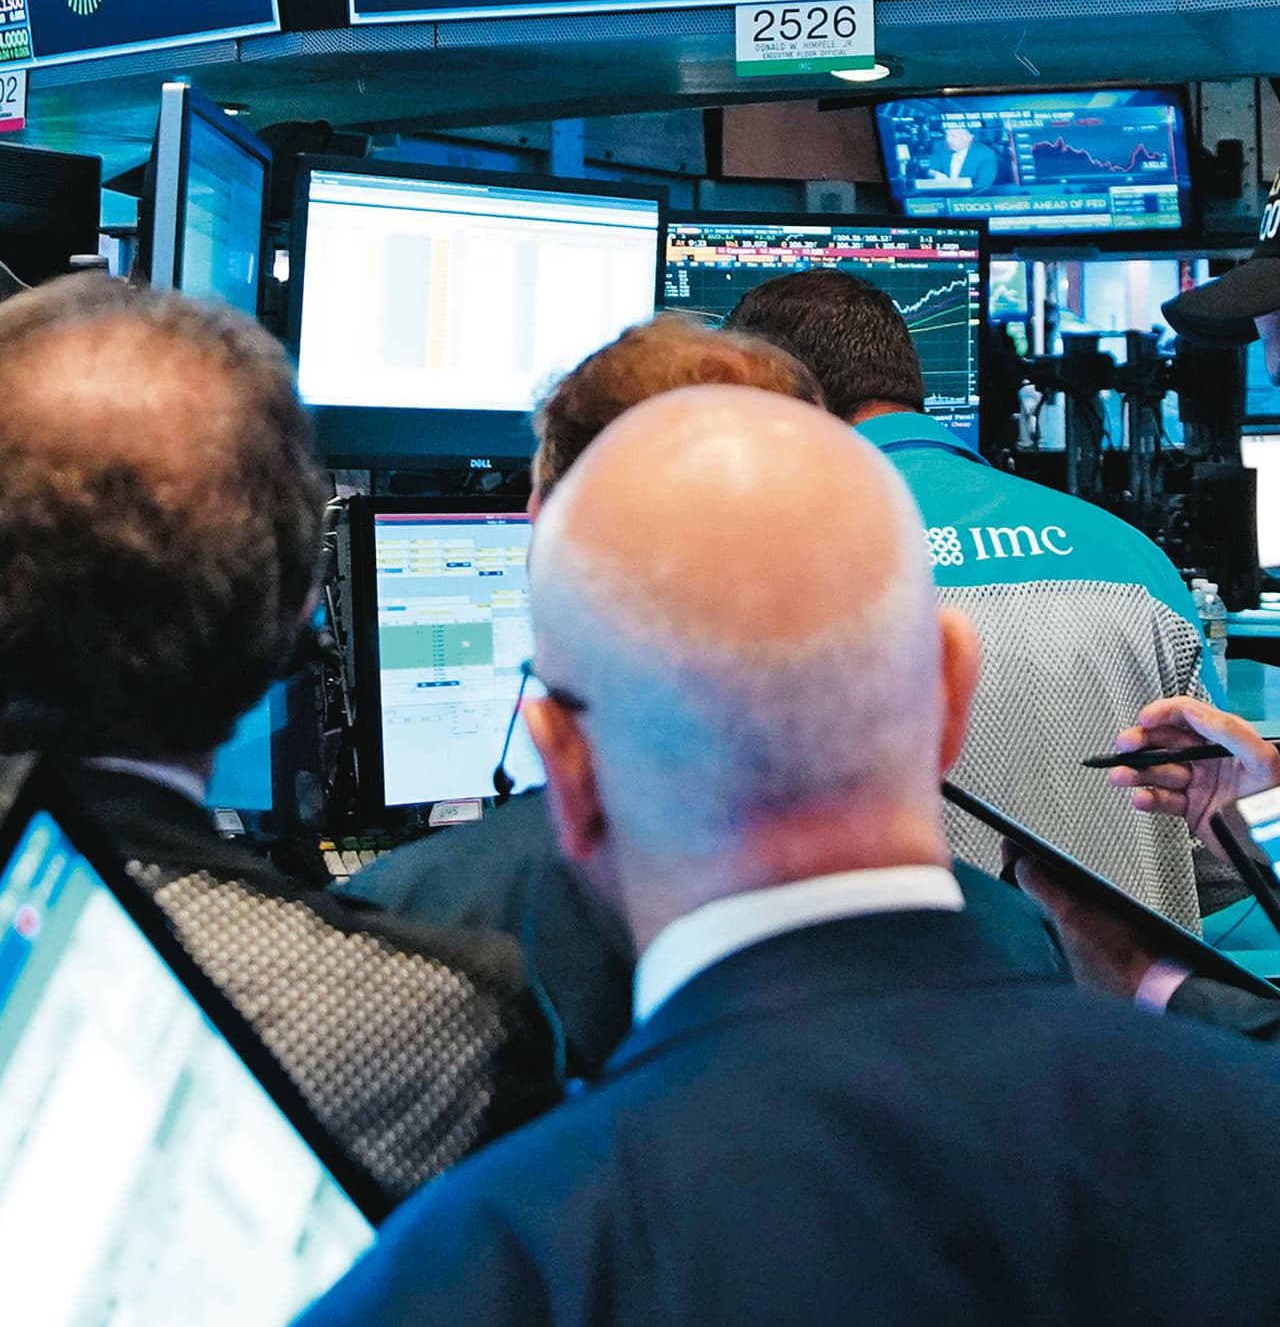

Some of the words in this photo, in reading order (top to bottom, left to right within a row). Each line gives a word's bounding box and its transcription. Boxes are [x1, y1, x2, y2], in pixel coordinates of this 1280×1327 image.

[754, 6, 856, 42] 2526
[470, 458, 492, 468] DELL
[969, 525, 1073, 561] imc
